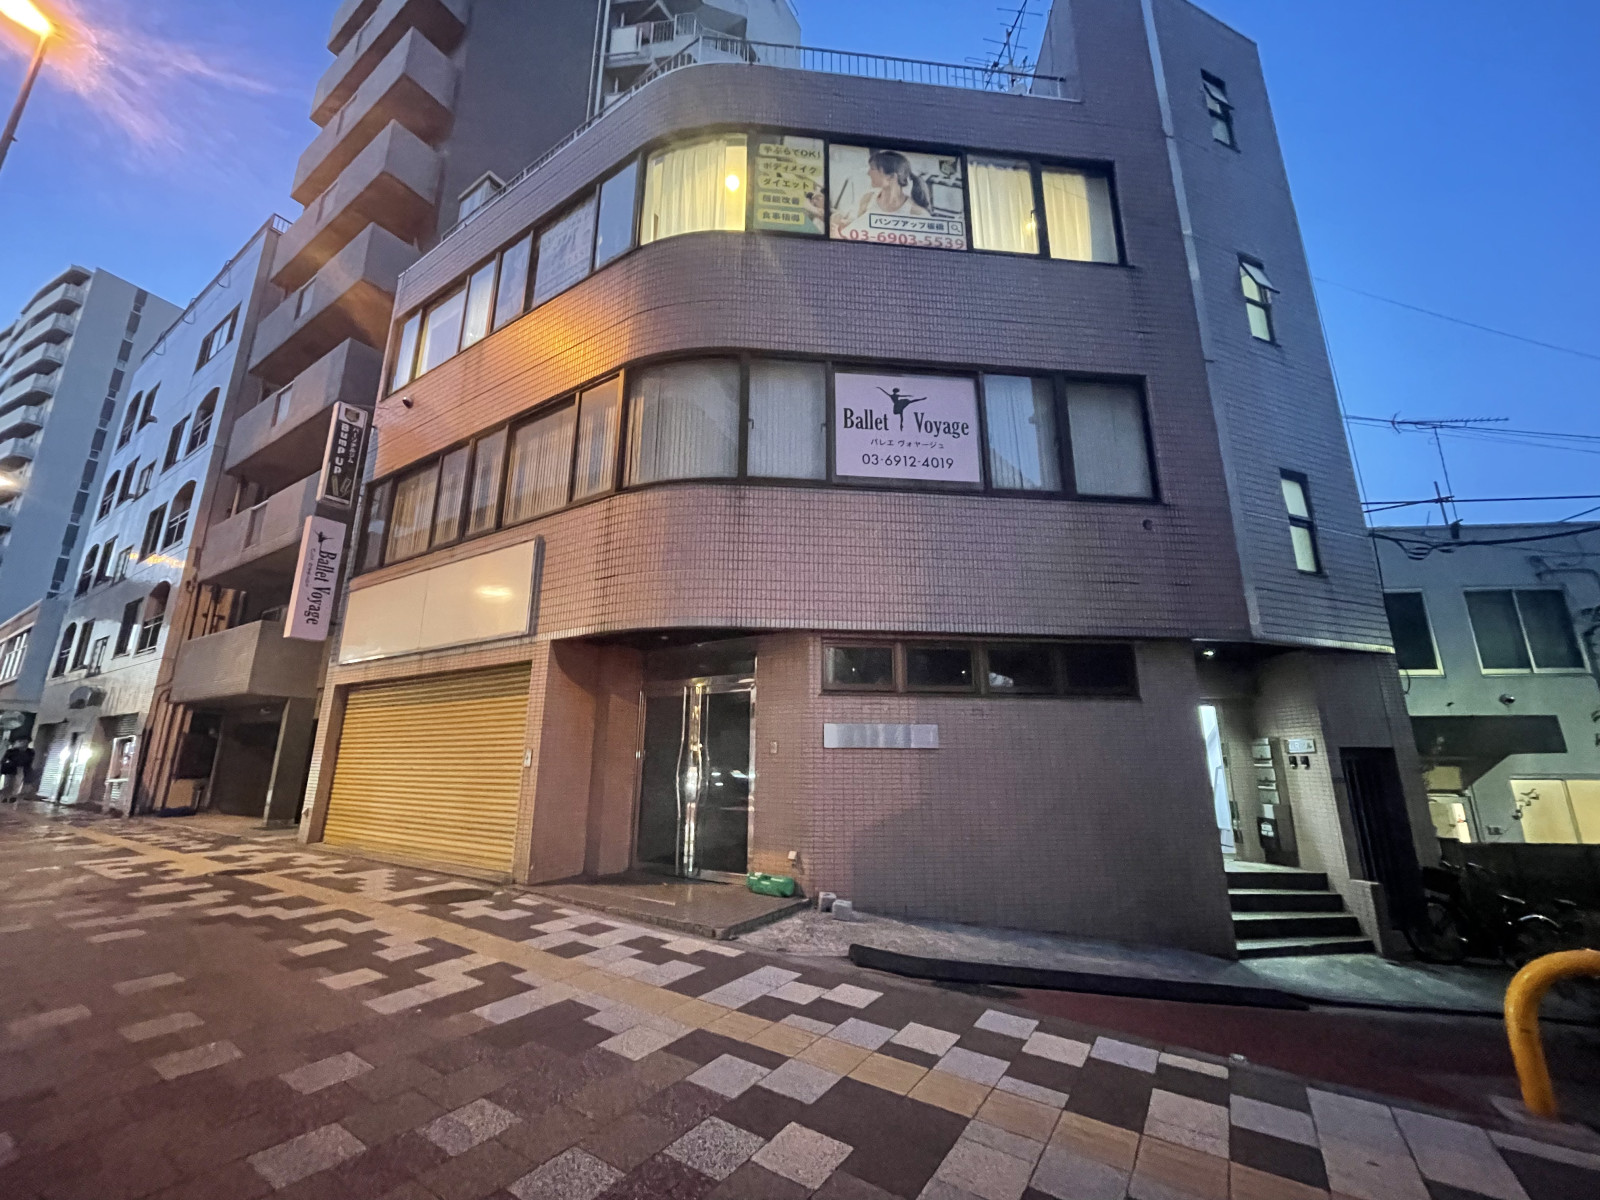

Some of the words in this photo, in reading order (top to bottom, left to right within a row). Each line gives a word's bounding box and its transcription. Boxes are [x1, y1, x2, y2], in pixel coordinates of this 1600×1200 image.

[763, 162, 817, 175] ボディメイク
[763, 178, 810, 190] ダイエット
[849, 228, 965, 250] 03-6903-5539
[843, 407, 890, 431] Ballet
[913, 411, 970, 439] Voyage
[862, 453, 954, 469] 03-6912-4019
[314, 549, 337, 583] Ballet
[304, 586, 331, 625] Voyage
